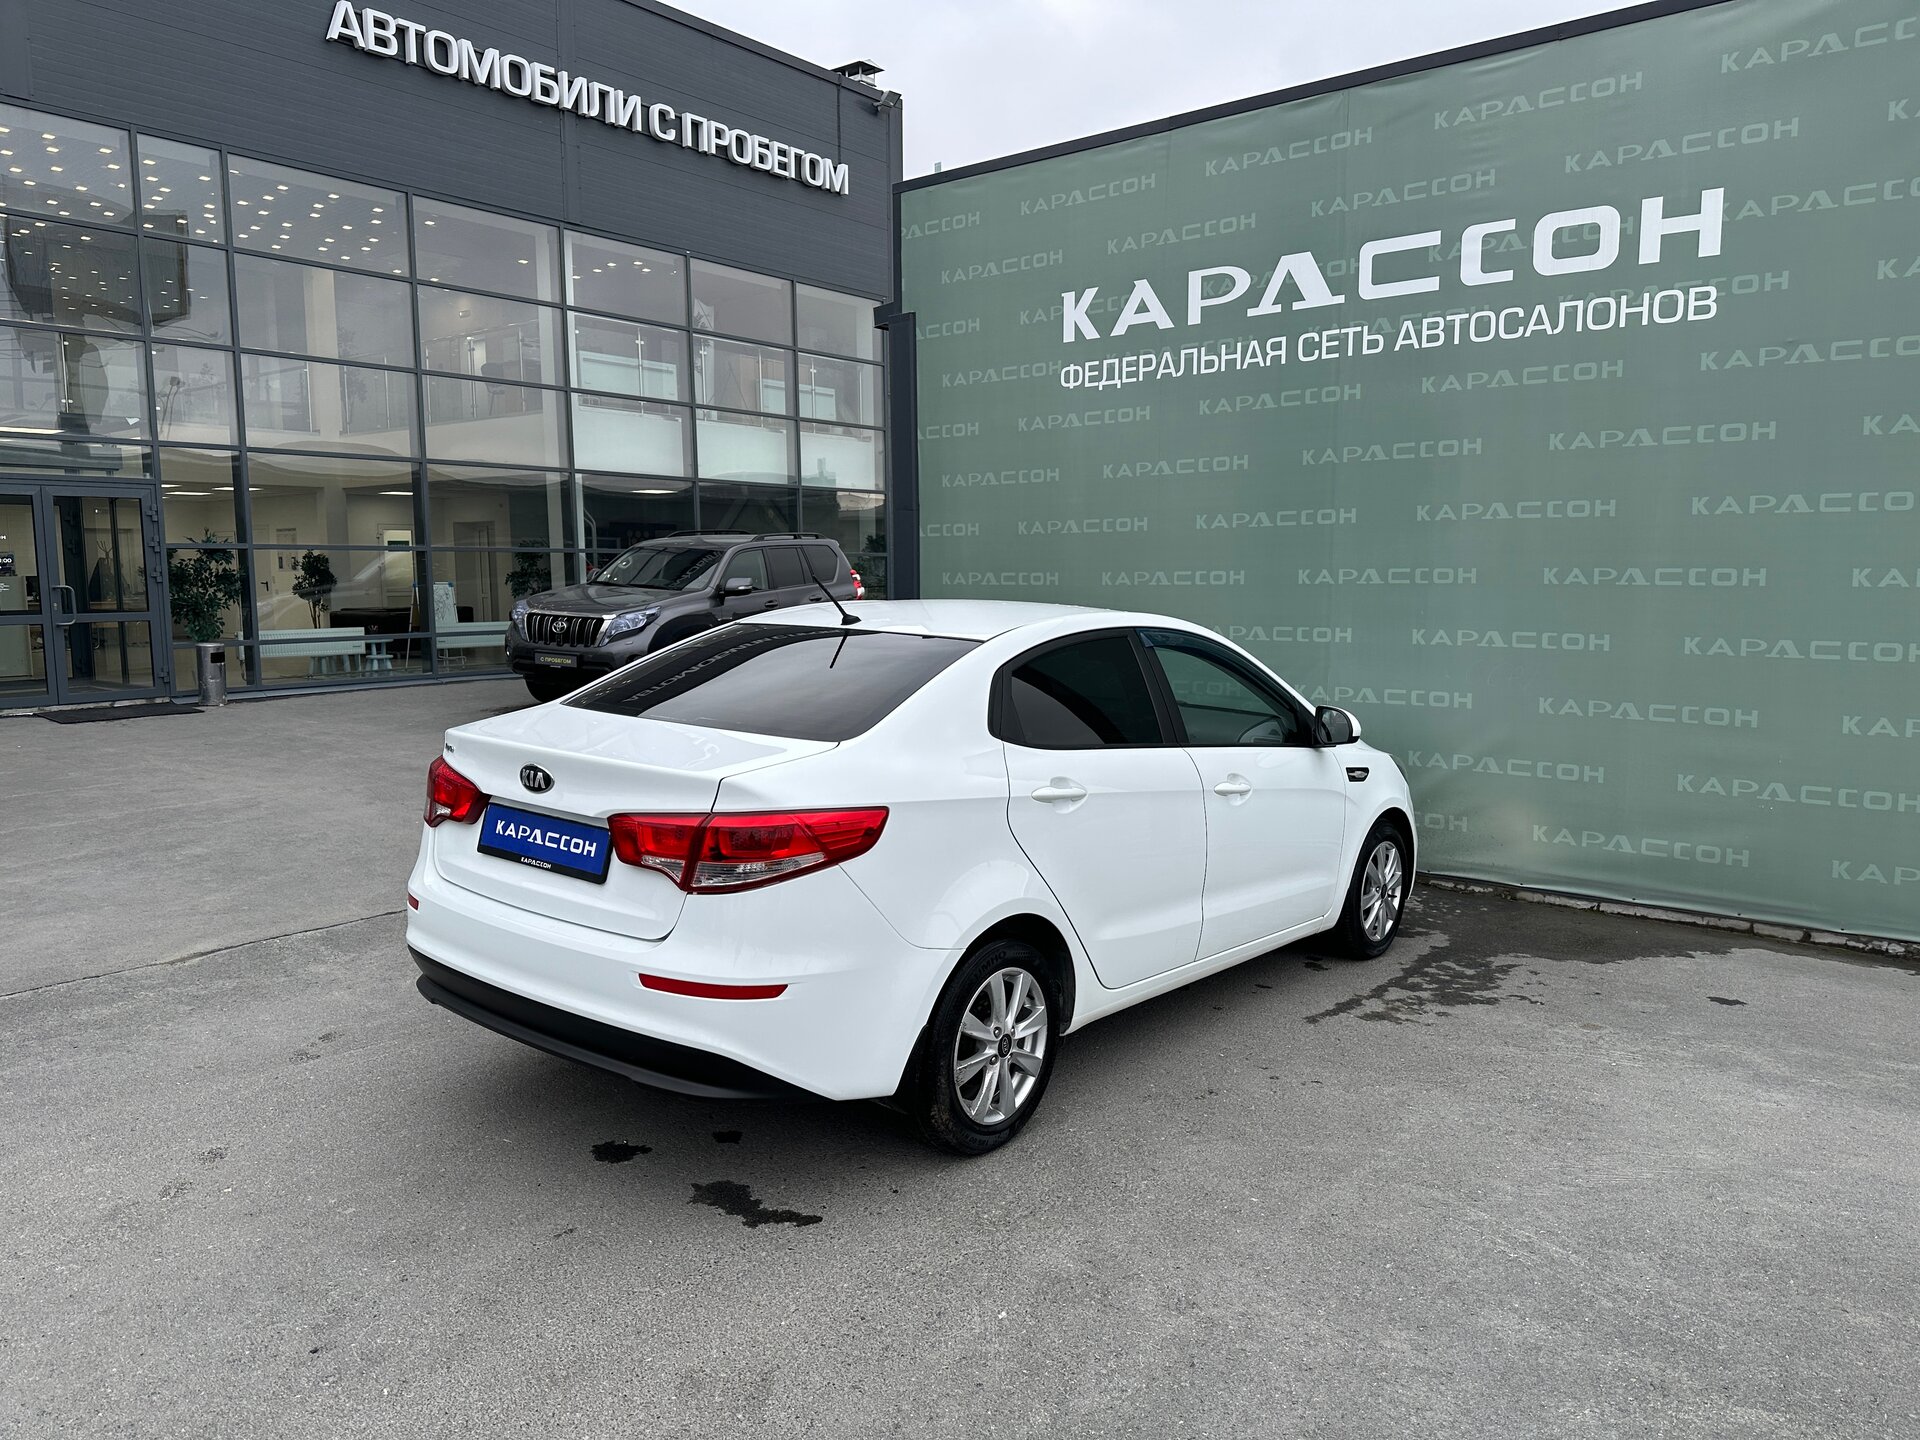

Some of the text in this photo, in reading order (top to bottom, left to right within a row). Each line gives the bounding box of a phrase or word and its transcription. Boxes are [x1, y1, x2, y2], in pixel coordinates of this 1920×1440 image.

[1721, 17, 1918, 74] КАРАСС
[326, 0, 849, 195] АВТОМОБИЛИ С ПРОБЕГОМ
[1434, 72, 1643, 130] КАРАССОН
[1205, 126, 1373, 177] КАРАССОН
[1565, 117, 1799, 173] КАРАССОН
[1020, 173, 1156, 216] КАРАССОН
[1310, 168, 1496, 218] КАРАССОН
[1722, 177, 1920, 222] АРАСС
[901, 211, 980, 239] АССОН
[1107, 212, 1256, 255] КАРАССОН
[941, 249, 1063, 285] КАРАССОН
[1061, 187, 1724, 343] КАРАССОН
[916, 318, 980, 340] ССОН
[1060, 285, 1718, 390] ФЕДЕРАЛЬНАЯ СЕТЬ АВТОСАЛОНОВ
[1700, 335, 1920, 371] КАРАССО
[1421, 360, 1623, 394] КАРАССОН
[1199, 383, 1361, 415] КАРАССОН
[918, 422, 979, 440] ССОН
[1018, 405, 1150, 432] КАРАССОН
[1549, 421, 1776, 450] КАРАССОН
[1102, 454, 1249, 479] КАРАССОН
[1302, 438, 1482, 466] КАРАССОН
[942, 468, 1059, 487] КАРАССОН
[1417, 499, 1617, 522] КАРАССОН
[1692, 492, 1915, 516] КАРАССО
[919, 523, 979, 537] ССОН
[1018, 516, 1148, 535] КАРАССОН
[1195, 508, 1356, 530] КАРАССОН
[942, 571, 1059, 586] КАРАССОН
[1101, 569, 1246, 586] КАРАССОН
[1298, 568, 1477, 585] КАРАССОН
[1544, 567, 1767, 586] КАРАССОН
[1412, 629, 1611, 651] КАРАССОН
[1538, 697, 1758, 728] КАРАССОН
[521, 768, 546, 789] KIA
[1407, 750, 1605, 784] КАРАССОН
[495, 819, 597, 858] КАРАССОН
[1533, 825, 1750, 867] КАРАССОН
[521, 856, 552, 869] КАРАССОН
